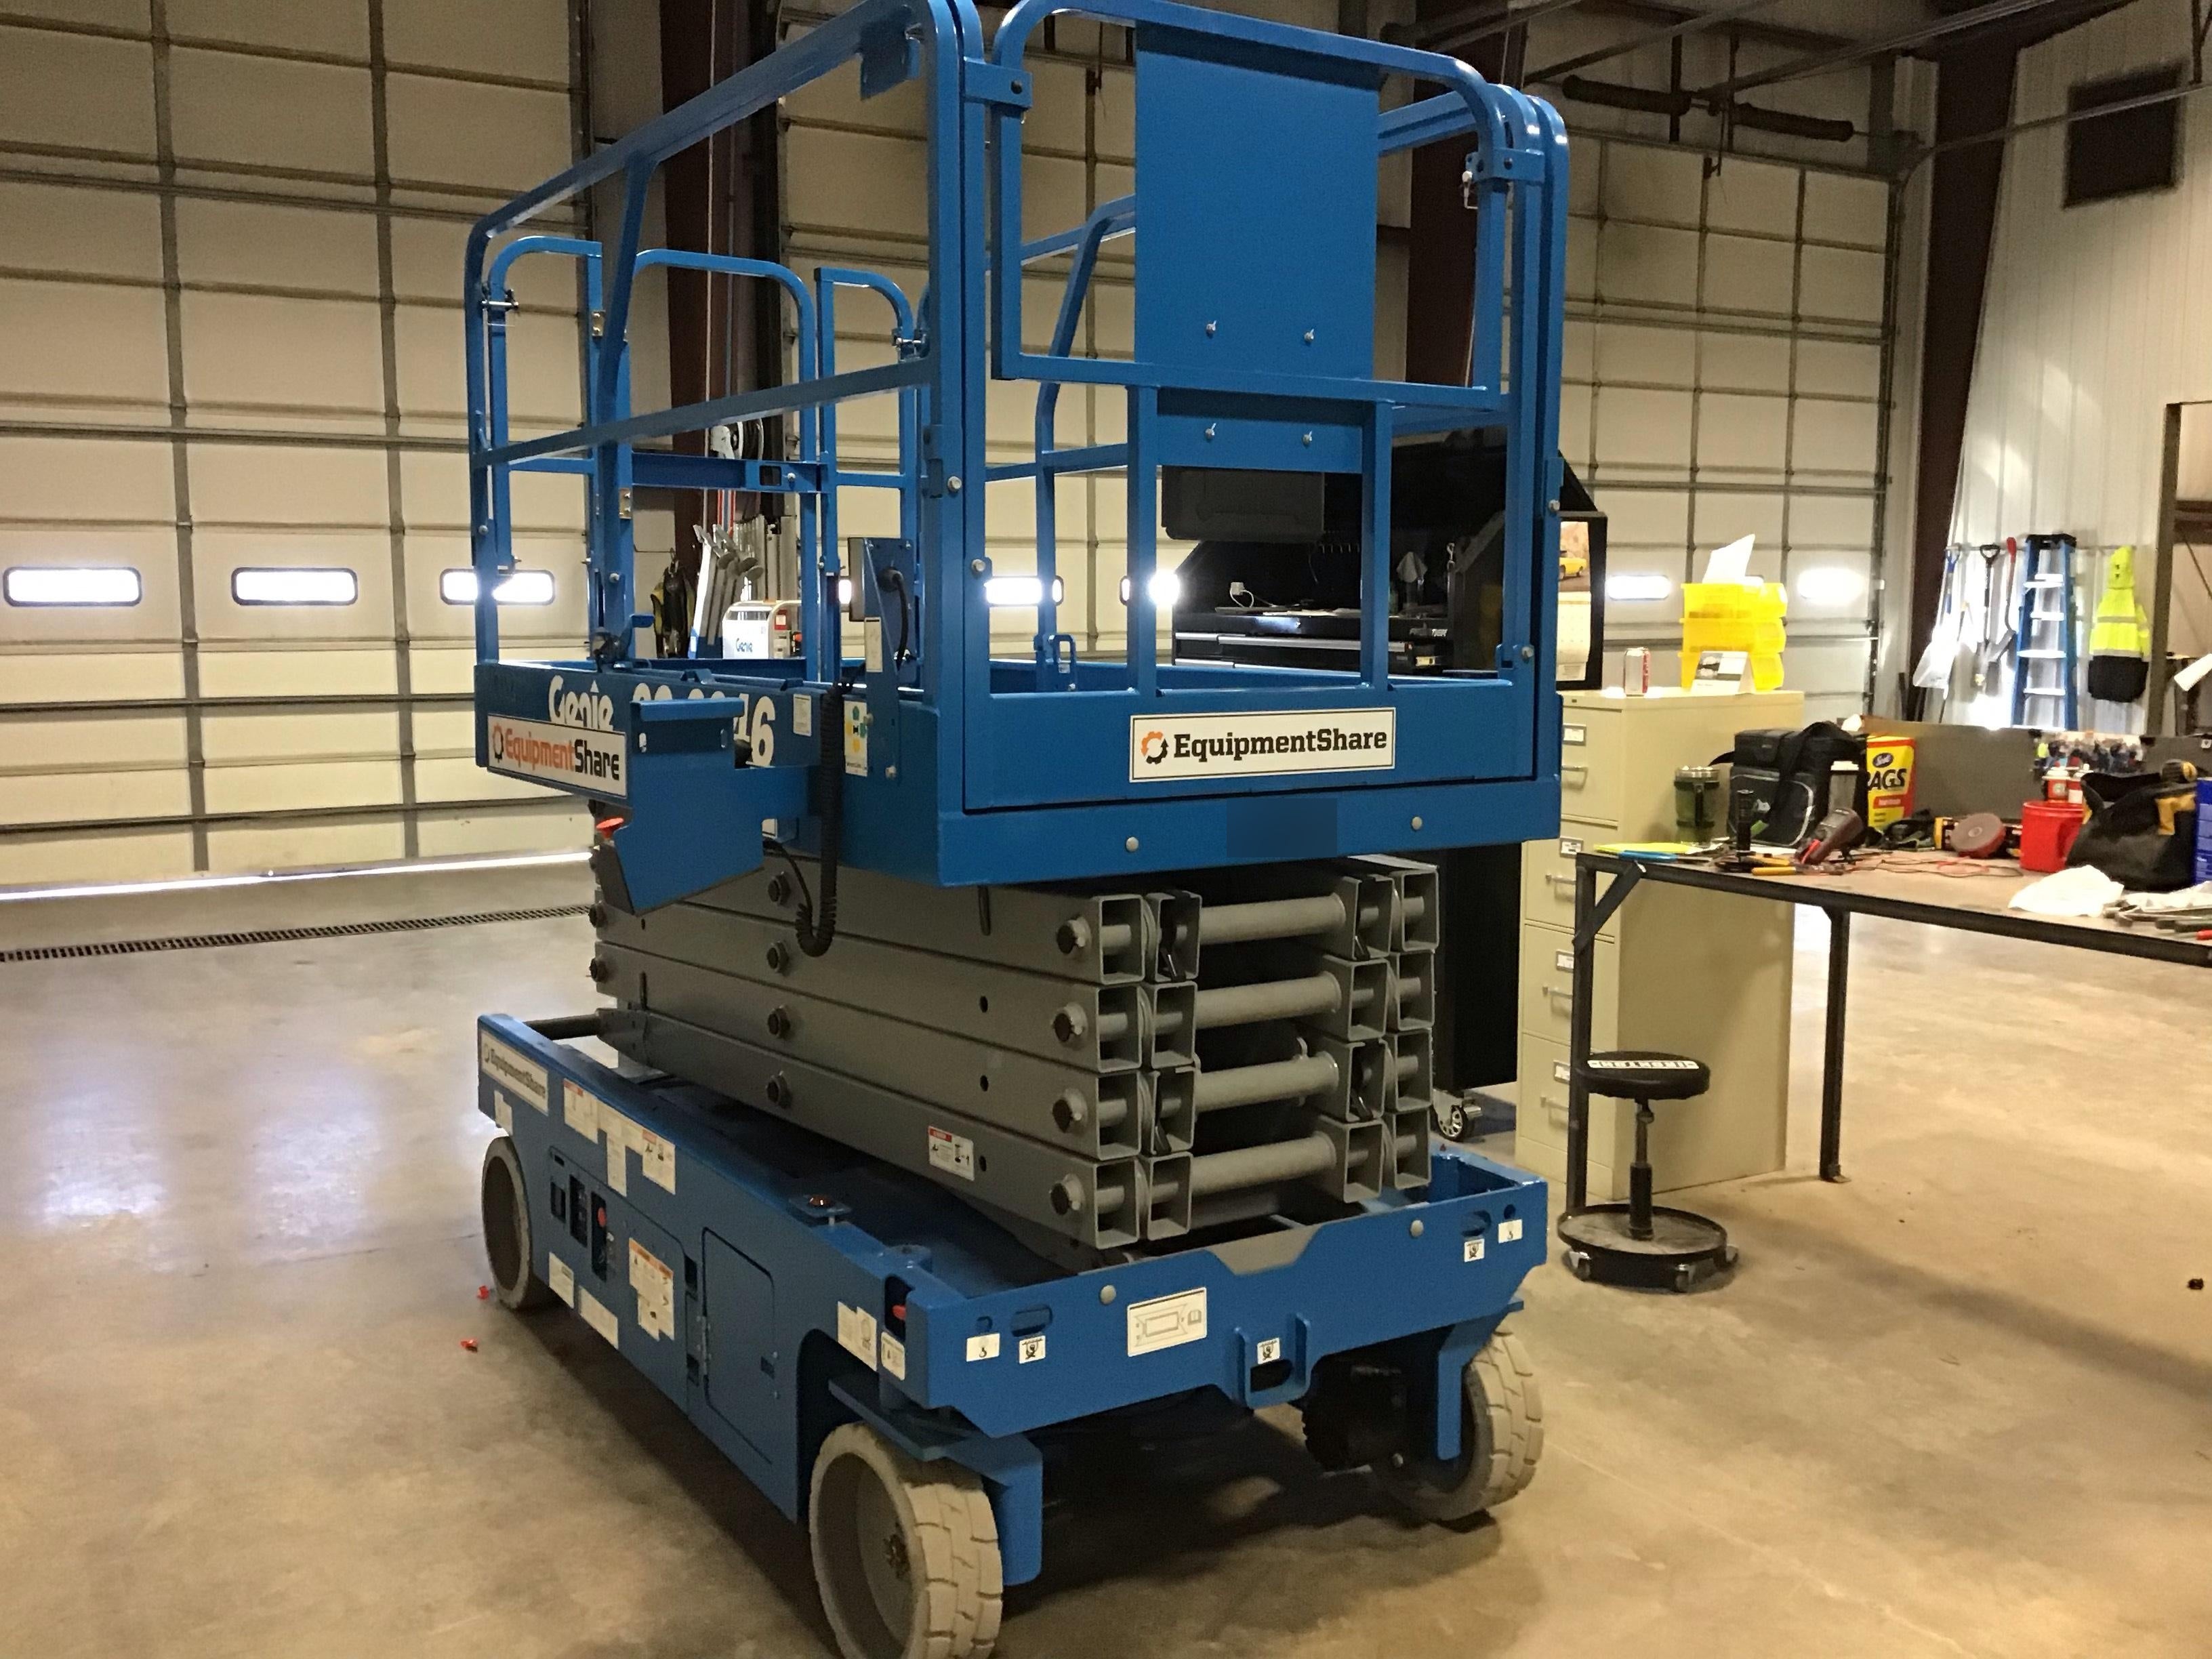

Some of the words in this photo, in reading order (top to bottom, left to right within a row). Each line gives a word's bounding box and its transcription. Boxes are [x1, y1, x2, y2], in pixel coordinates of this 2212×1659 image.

[548, 674, 613, 731] Genie
[504, 728, 619, 781] EquipmentShare
[1173, 728, 1387, 762] EquipmentShare
